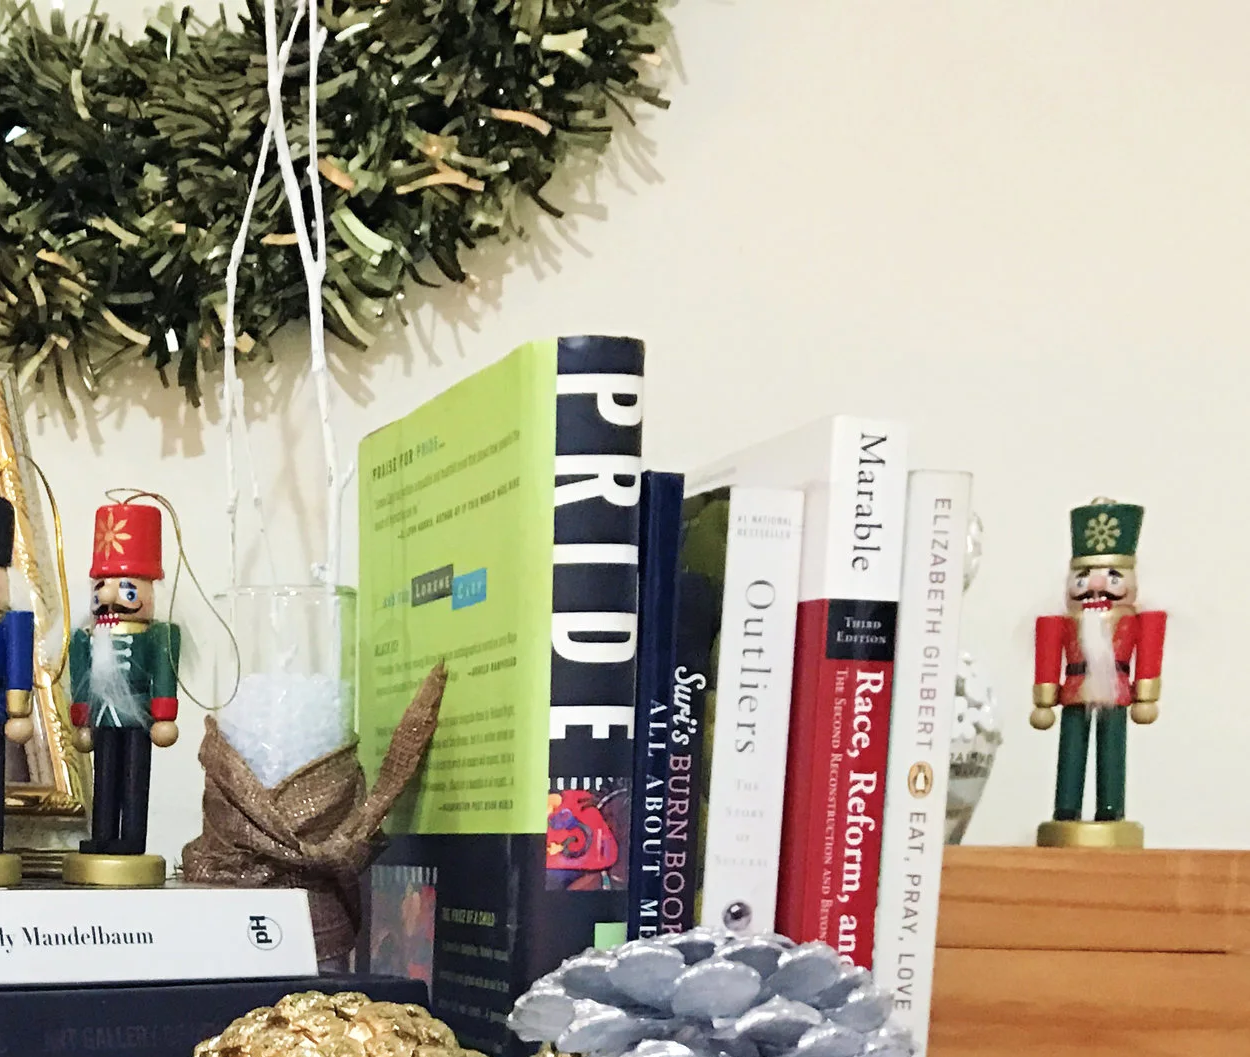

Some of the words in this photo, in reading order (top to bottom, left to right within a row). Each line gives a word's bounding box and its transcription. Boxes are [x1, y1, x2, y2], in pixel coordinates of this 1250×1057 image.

[851, 432, 888, 572] Marable
[549, 373, 644, 740] PRIDE
[924, 497, 952, 634] ELIZABETH
[671, 665, 707, 746] Suri's
[735, 579, 776, 753] Outliers
[846, 669, 885, 758] Race,
[916, 645, 940, 751] GILBERT
[647, 699, 668, 758] ALL
[642, 773, 665, 877] ABOUT
[666, 753, 692, 841] BURN
[836, 770, 878, 903] Reform,
[23, 924, 154, 948] Mandelbaum
[818, 898, 834, 943] BEYON
[893, 952, 915, 1011] LOVE
